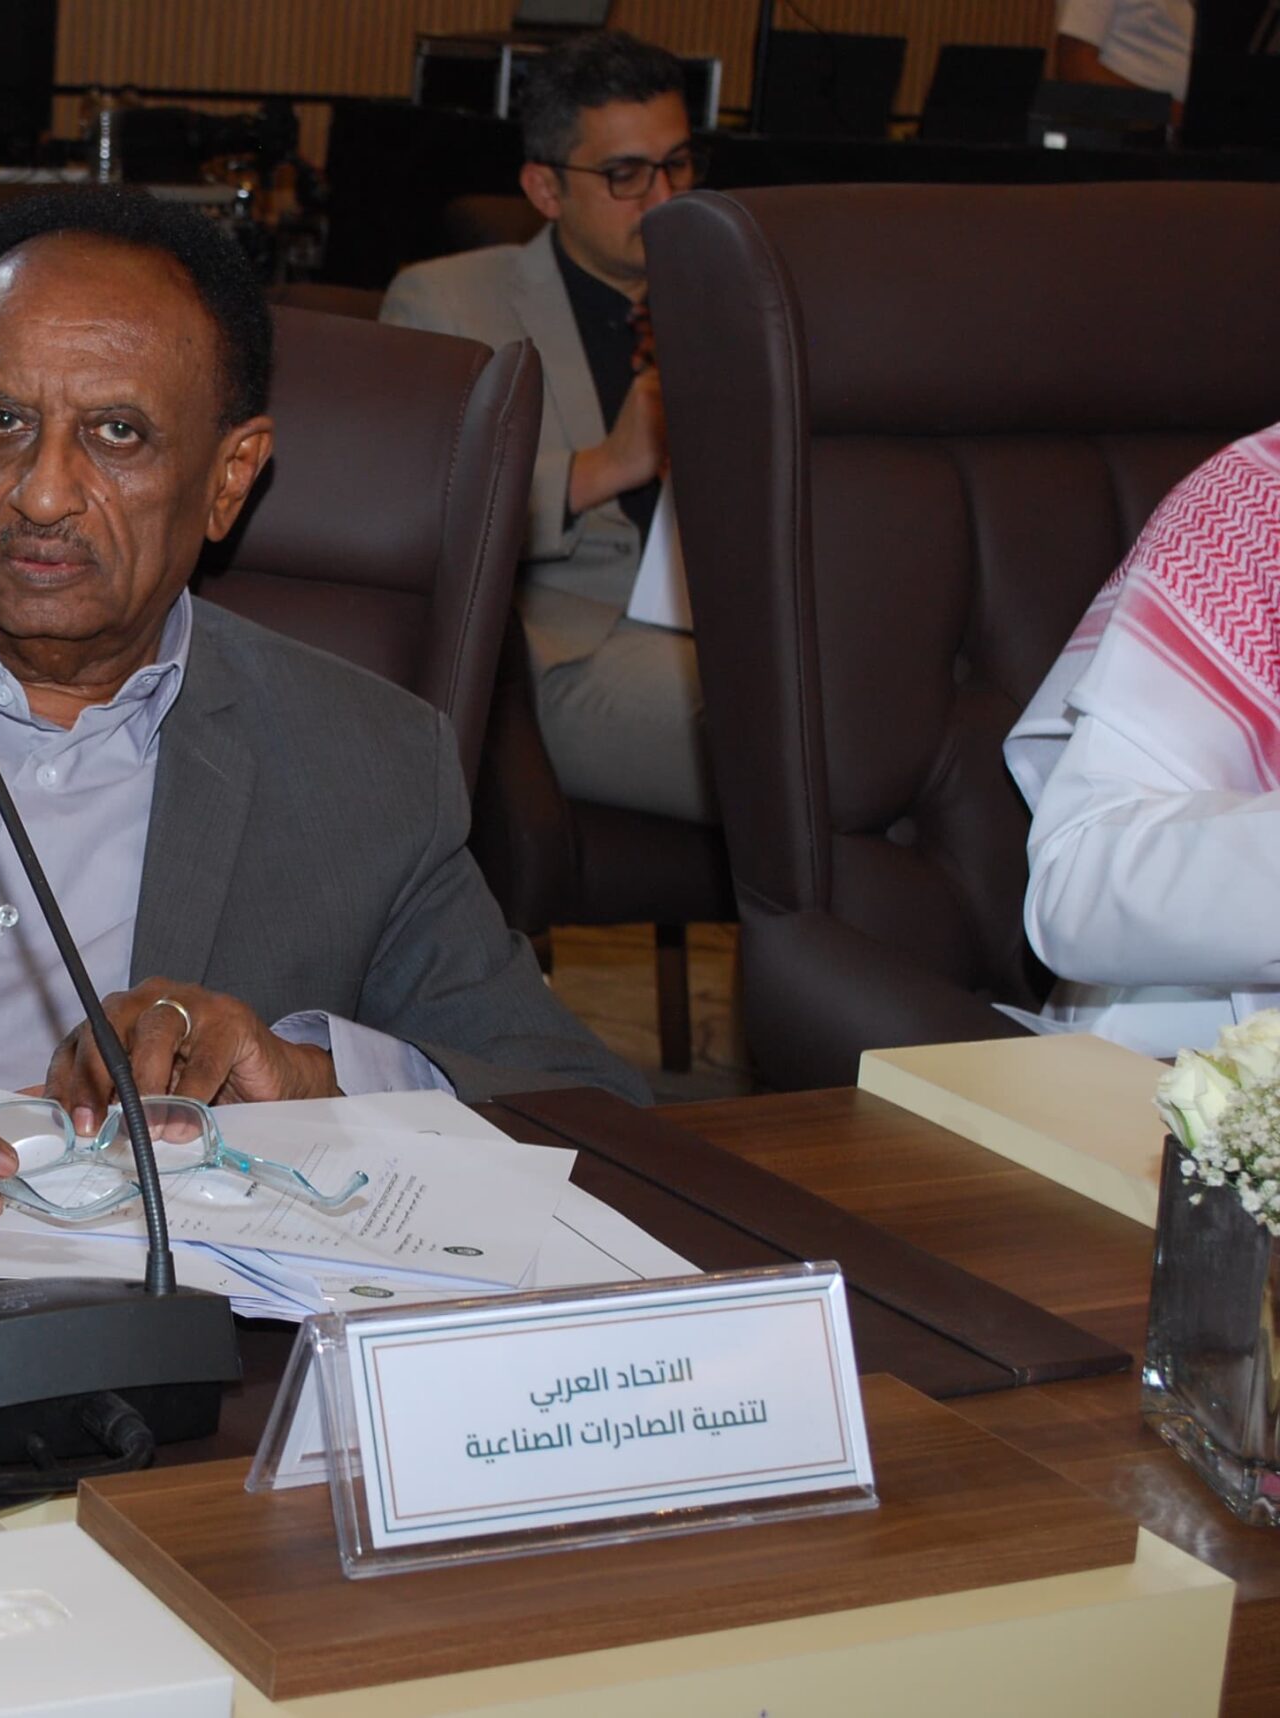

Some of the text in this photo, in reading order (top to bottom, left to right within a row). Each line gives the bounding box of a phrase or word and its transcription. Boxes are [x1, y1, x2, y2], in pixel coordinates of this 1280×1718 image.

[529, 1357, 693, 1413] الاتحاد العربي
[466, 1399, 768, 1464] لتنمية الصادرات الصناعية
